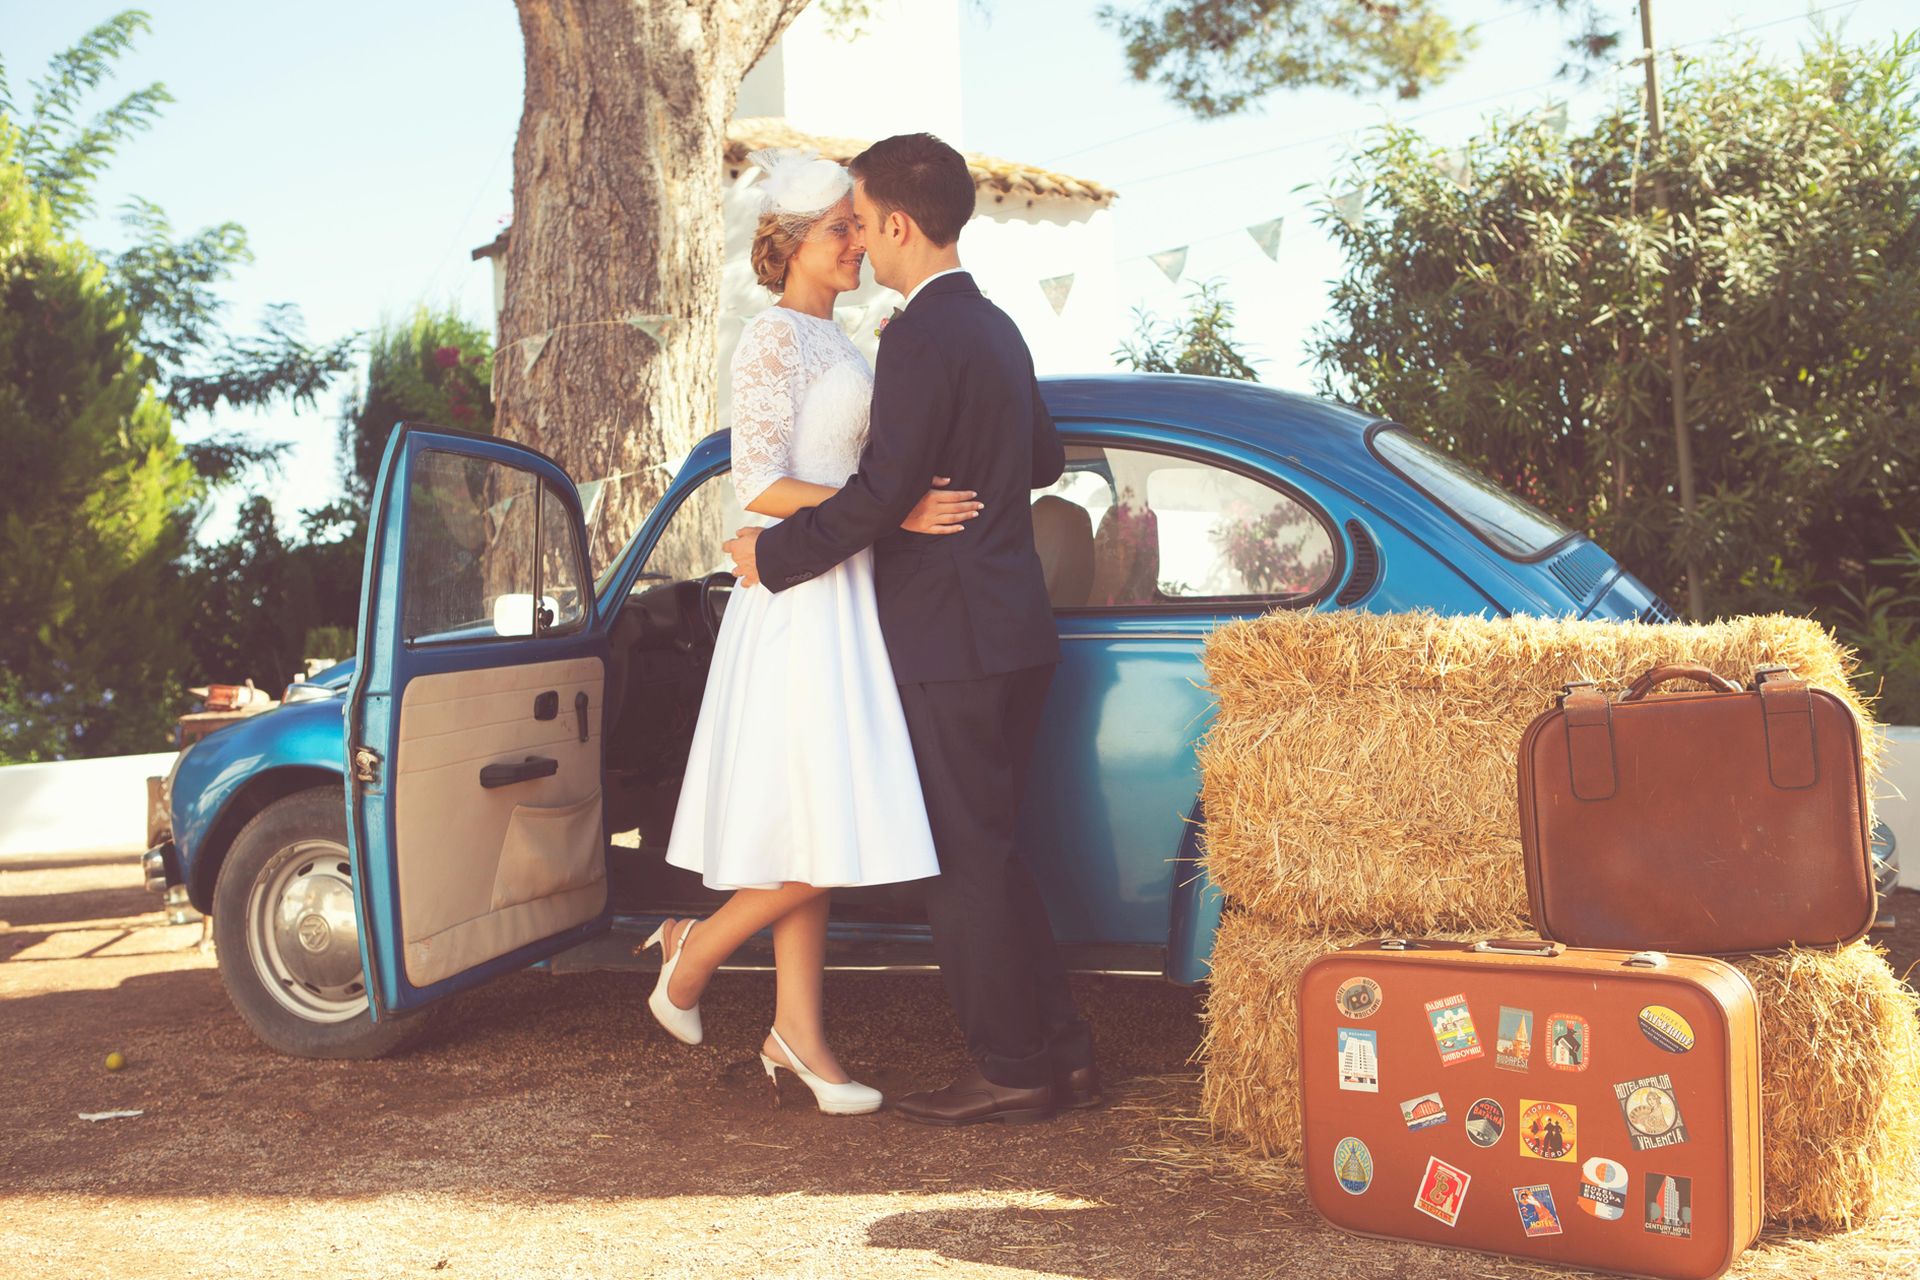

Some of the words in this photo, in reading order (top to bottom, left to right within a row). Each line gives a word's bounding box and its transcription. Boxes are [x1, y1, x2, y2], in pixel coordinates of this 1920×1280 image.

[1641, 1009, 1693, 1047] KAISERHOF
[1613, 1080, 1639, 1100] HOTEL
[1479, 1103, 1500, 1115] HOTEL
[1637, 1128, 1684, 1150] VALENCIA
[1524, 1137, 1572, 1158] AMSTERDAM
[1584, 1184, 1613, 1197] HOTEL
[1584, 1188, 1621, 1203] EVROPA
[1583, 1193, 1609, 1204] BRNO
[1530, 1219, 1555, 1229] HOTEL
[1645, 1221, 1672, 1232] CENTURY
[1672, 1226, 1691, 1235] HOTEL
